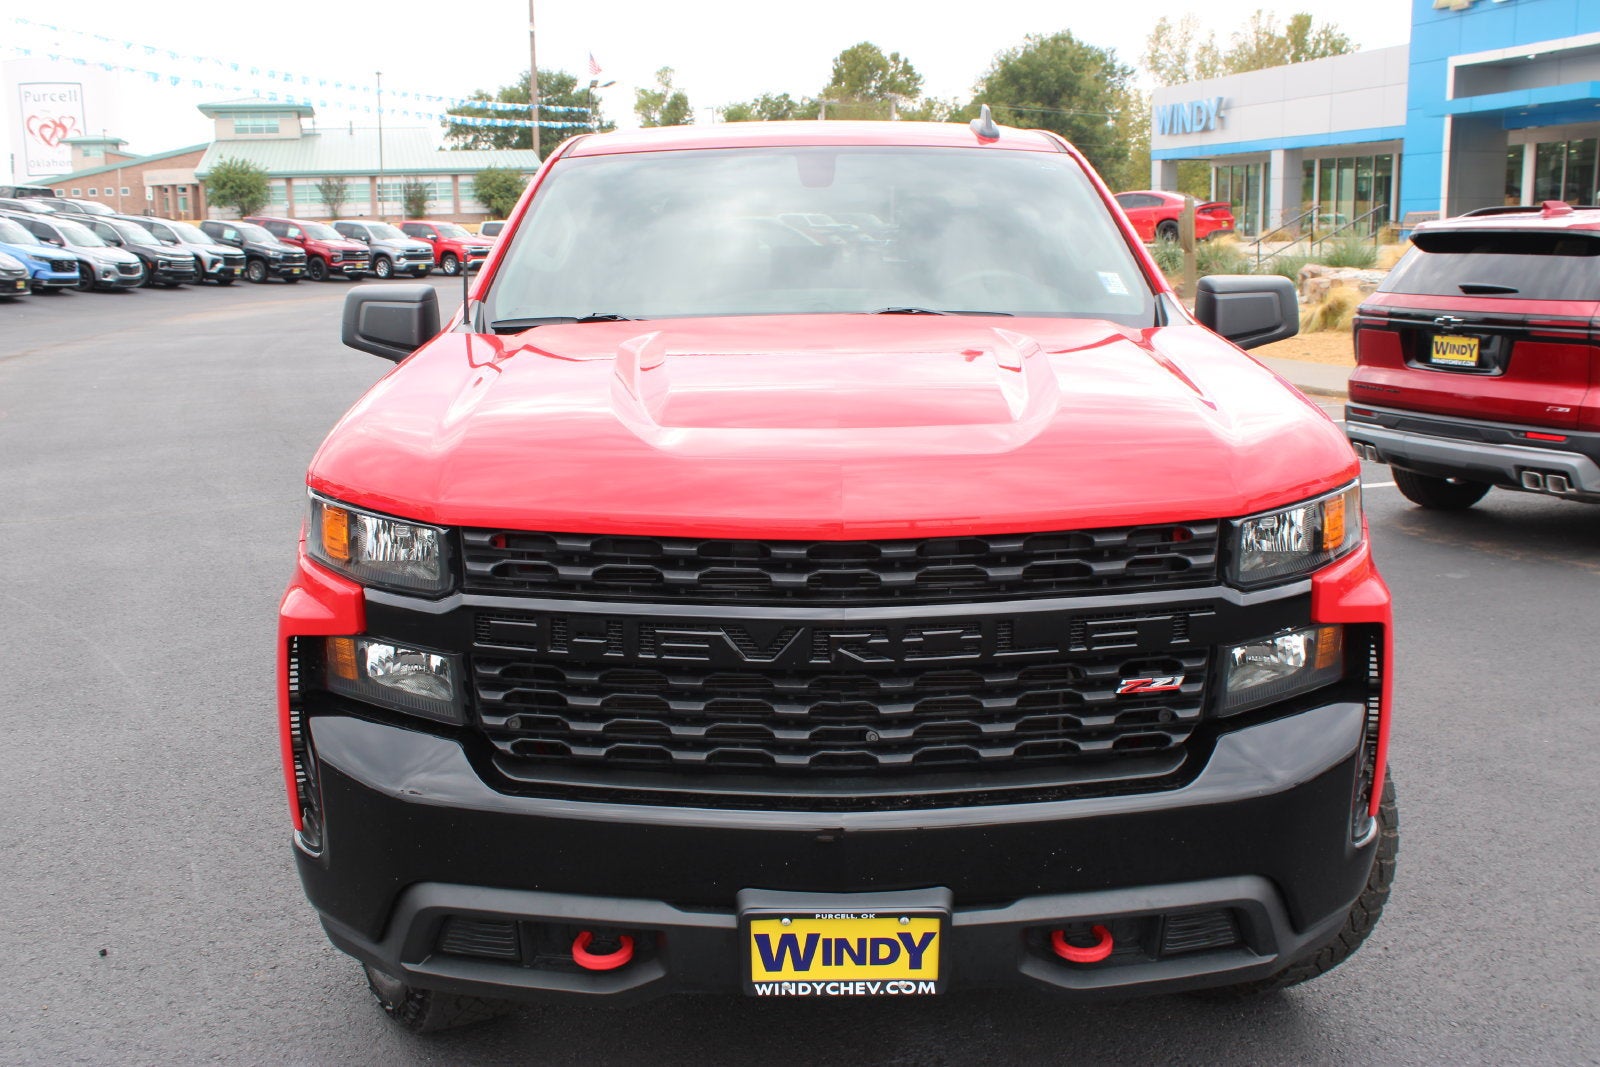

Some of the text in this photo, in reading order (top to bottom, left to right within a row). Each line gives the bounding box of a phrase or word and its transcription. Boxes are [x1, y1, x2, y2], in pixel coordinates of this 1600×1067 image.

[24, 89, 78, 102] Purcell
[1155, 96, 1224, 135] WINDY
[1434, 341, 1477, 358] WINDY
[473, 606, 1217, 663] CHEVROLET
[754, 932, 937, 972] WINDY
[755, 981, 936, 996] WINDYCHEV.COM
